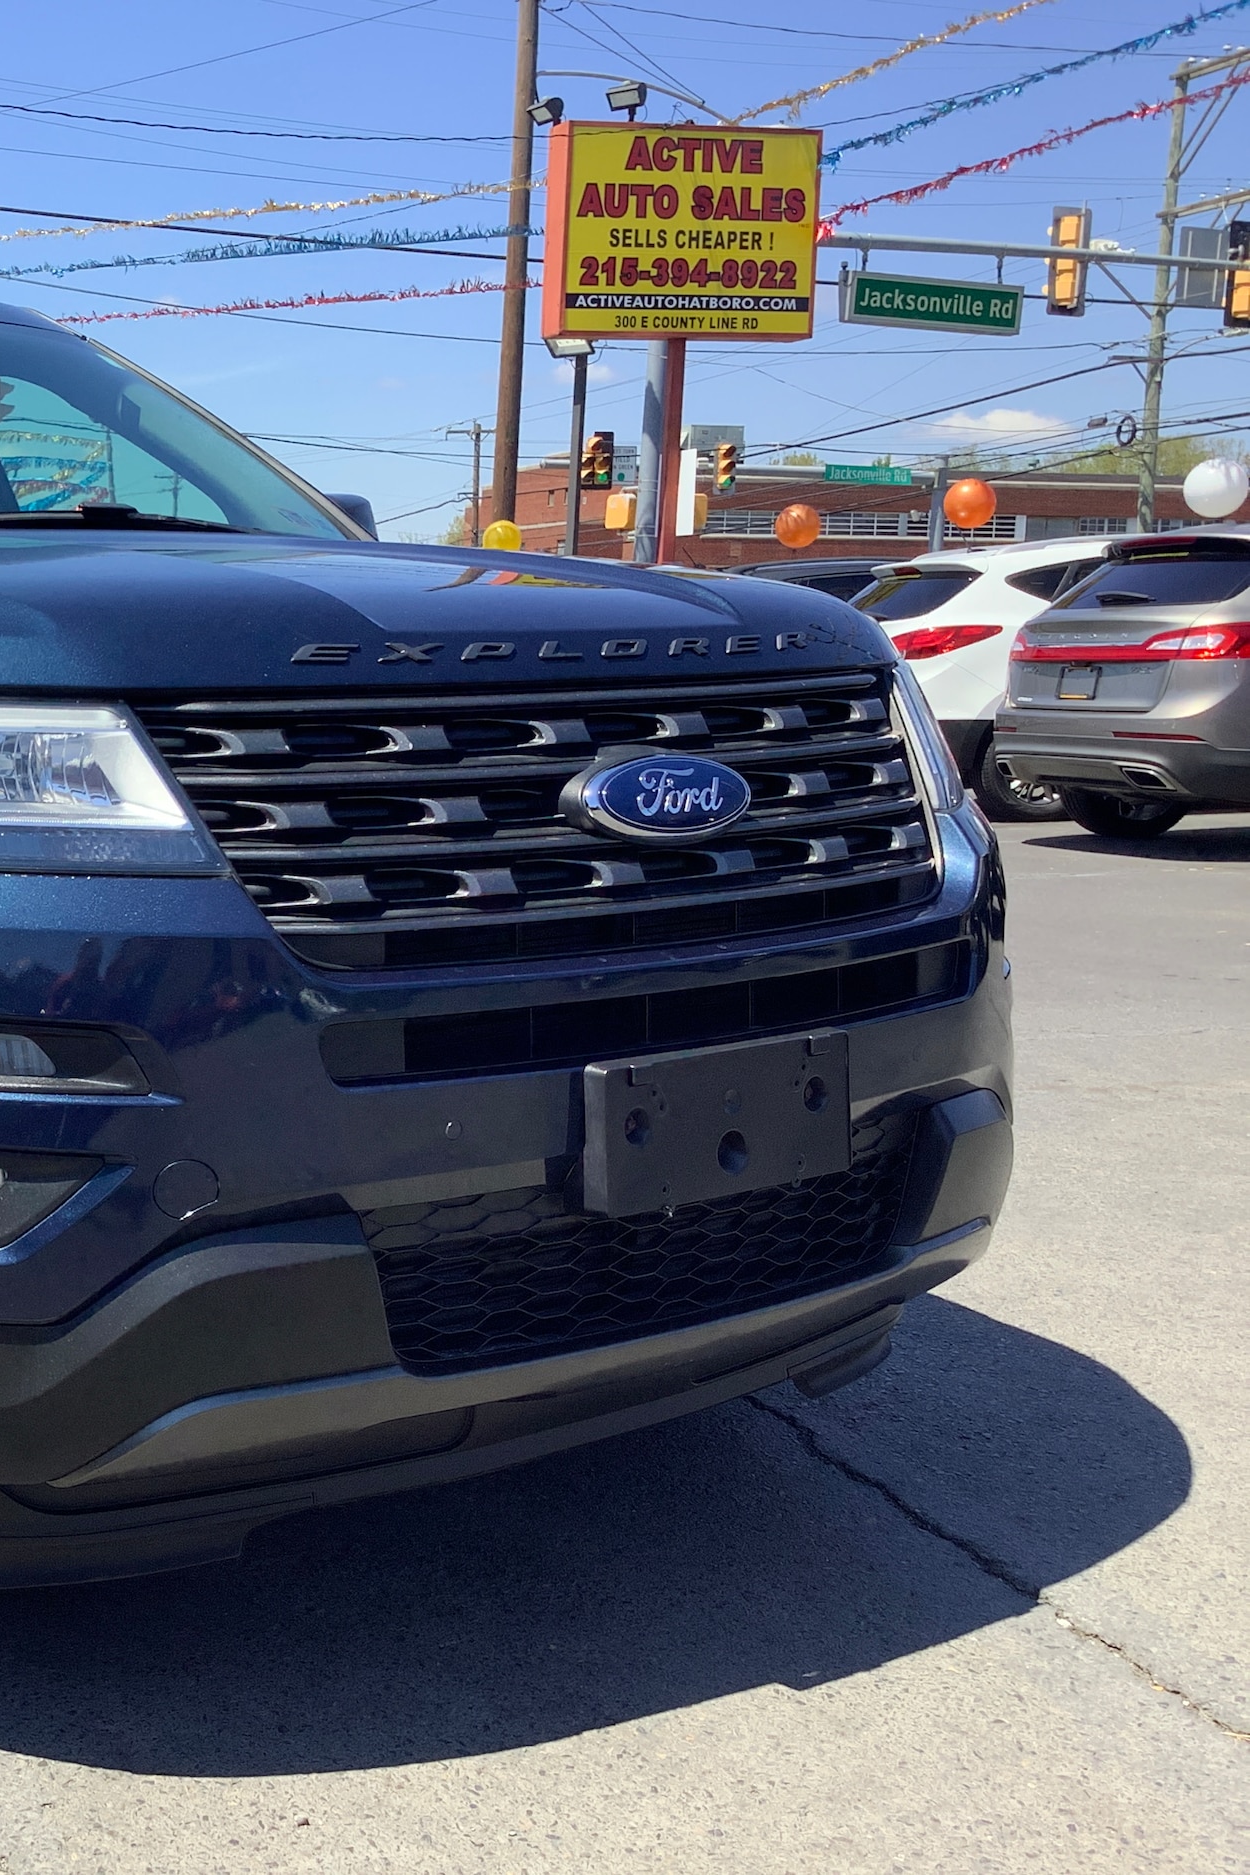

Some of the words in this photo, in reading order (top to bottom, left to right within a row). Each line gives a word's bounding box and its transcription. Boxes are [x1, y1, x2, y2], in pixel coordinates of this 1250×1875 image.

[625, 136, 764, 175] ACTIVE
[576, 183, 679, 219] AUTO
[691, 185, 806, 223] SALES
[609, 228, 667, 248] SELLS
[675, 230, 762, 251] CHEAPER
[579, 256, 797, 289] 215-394-8922
[575, 294, 797, 311] ACTIVEAUTOHATBORO.COM
[859, 287, 983, 316] Jacksonville
[989, 299, 1013, 319] Rd
[615, 315, 637, 328] 300
[641, 316, 648, 328] E
[653, 316, 705, 329] COUNTY
[709, 317, 738, 329] LINE
[742, 318, 759, 330] RD
[829, 466, 891, 482] Jacksonville
[893, 469, 907, 482] Rd
[290, 630, 810, 663] EXPLORER
[636, 768, 724, 816] Ford
